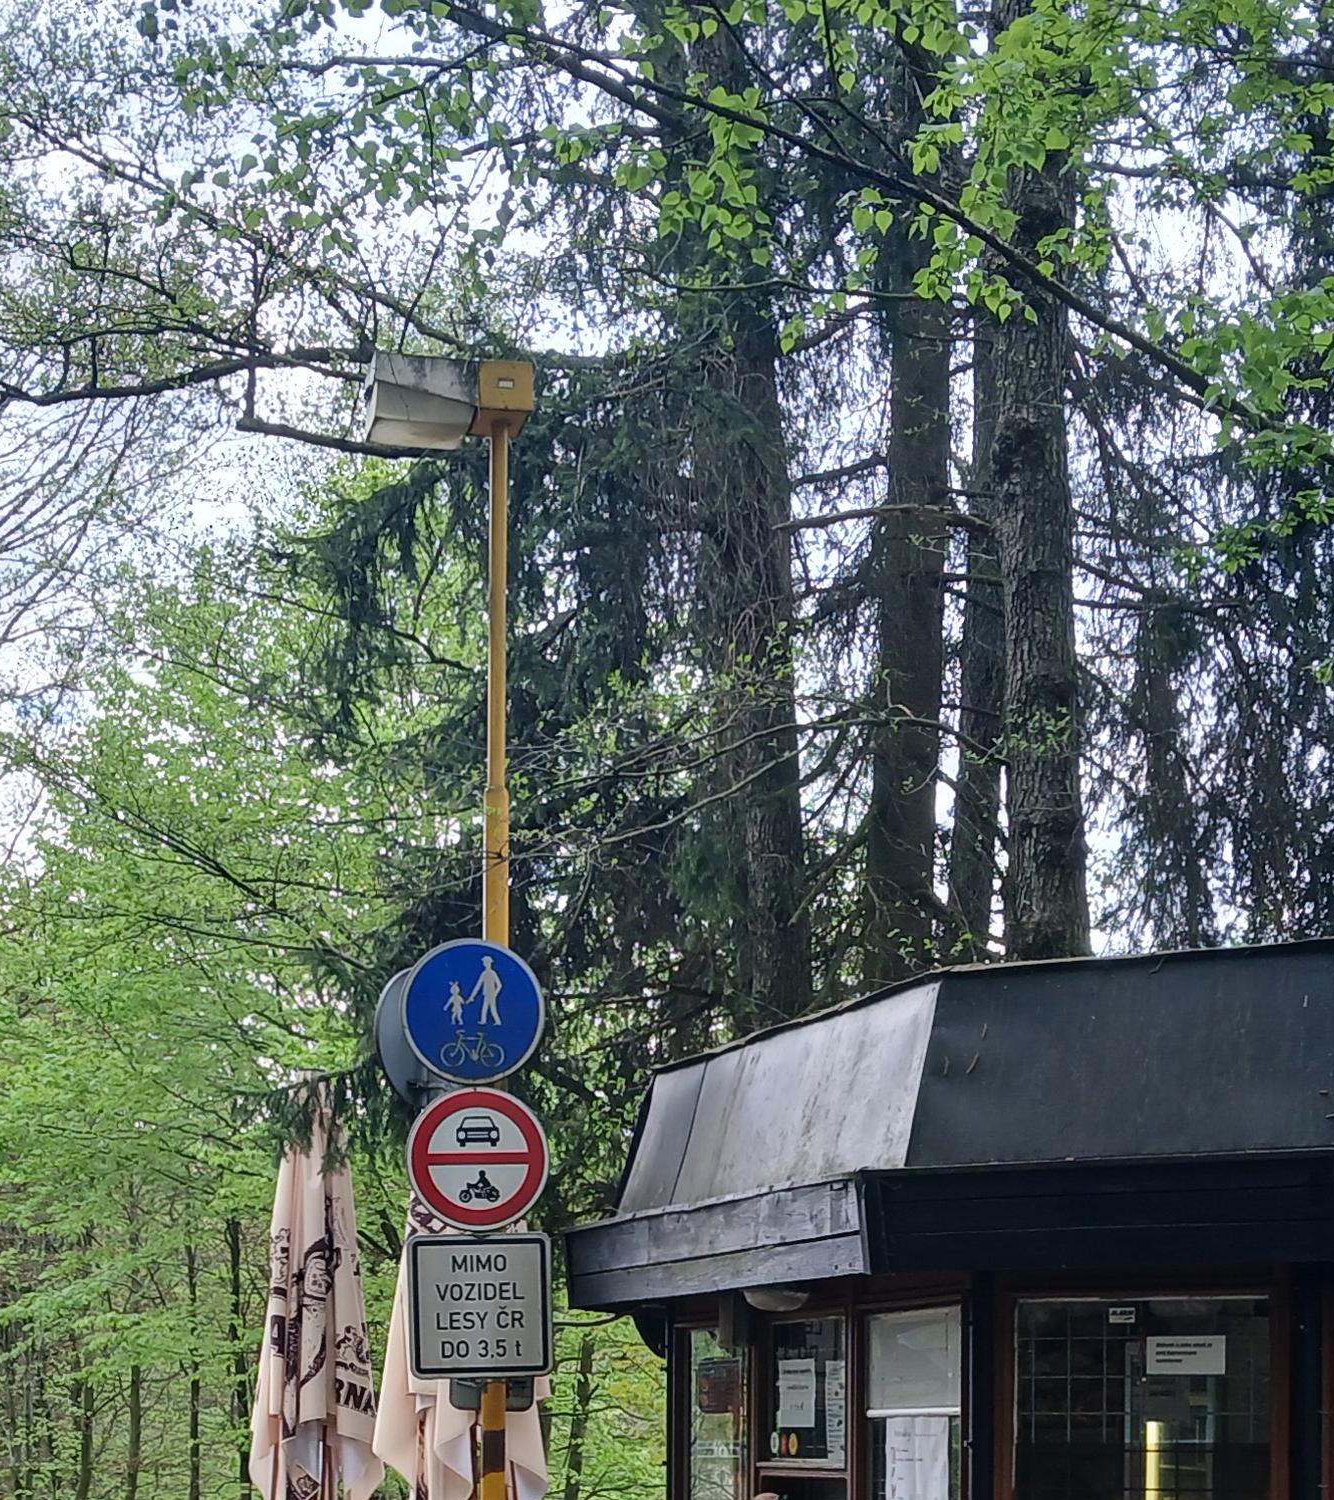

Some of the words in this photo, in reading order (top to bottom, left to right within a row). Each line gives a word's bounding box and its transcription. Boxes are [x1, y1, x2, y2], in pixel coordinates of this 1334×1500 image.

[451, 1254, 507, 1273] MIMO
[435, 1282, 525, 1302] VOZIDEL
[436, 1311, 489, 1331] LESY
[496, 1305, 525, 1329] ČR
[440, 1340, 470, 1359] DO
[514, 1339, 523, 1357] t
